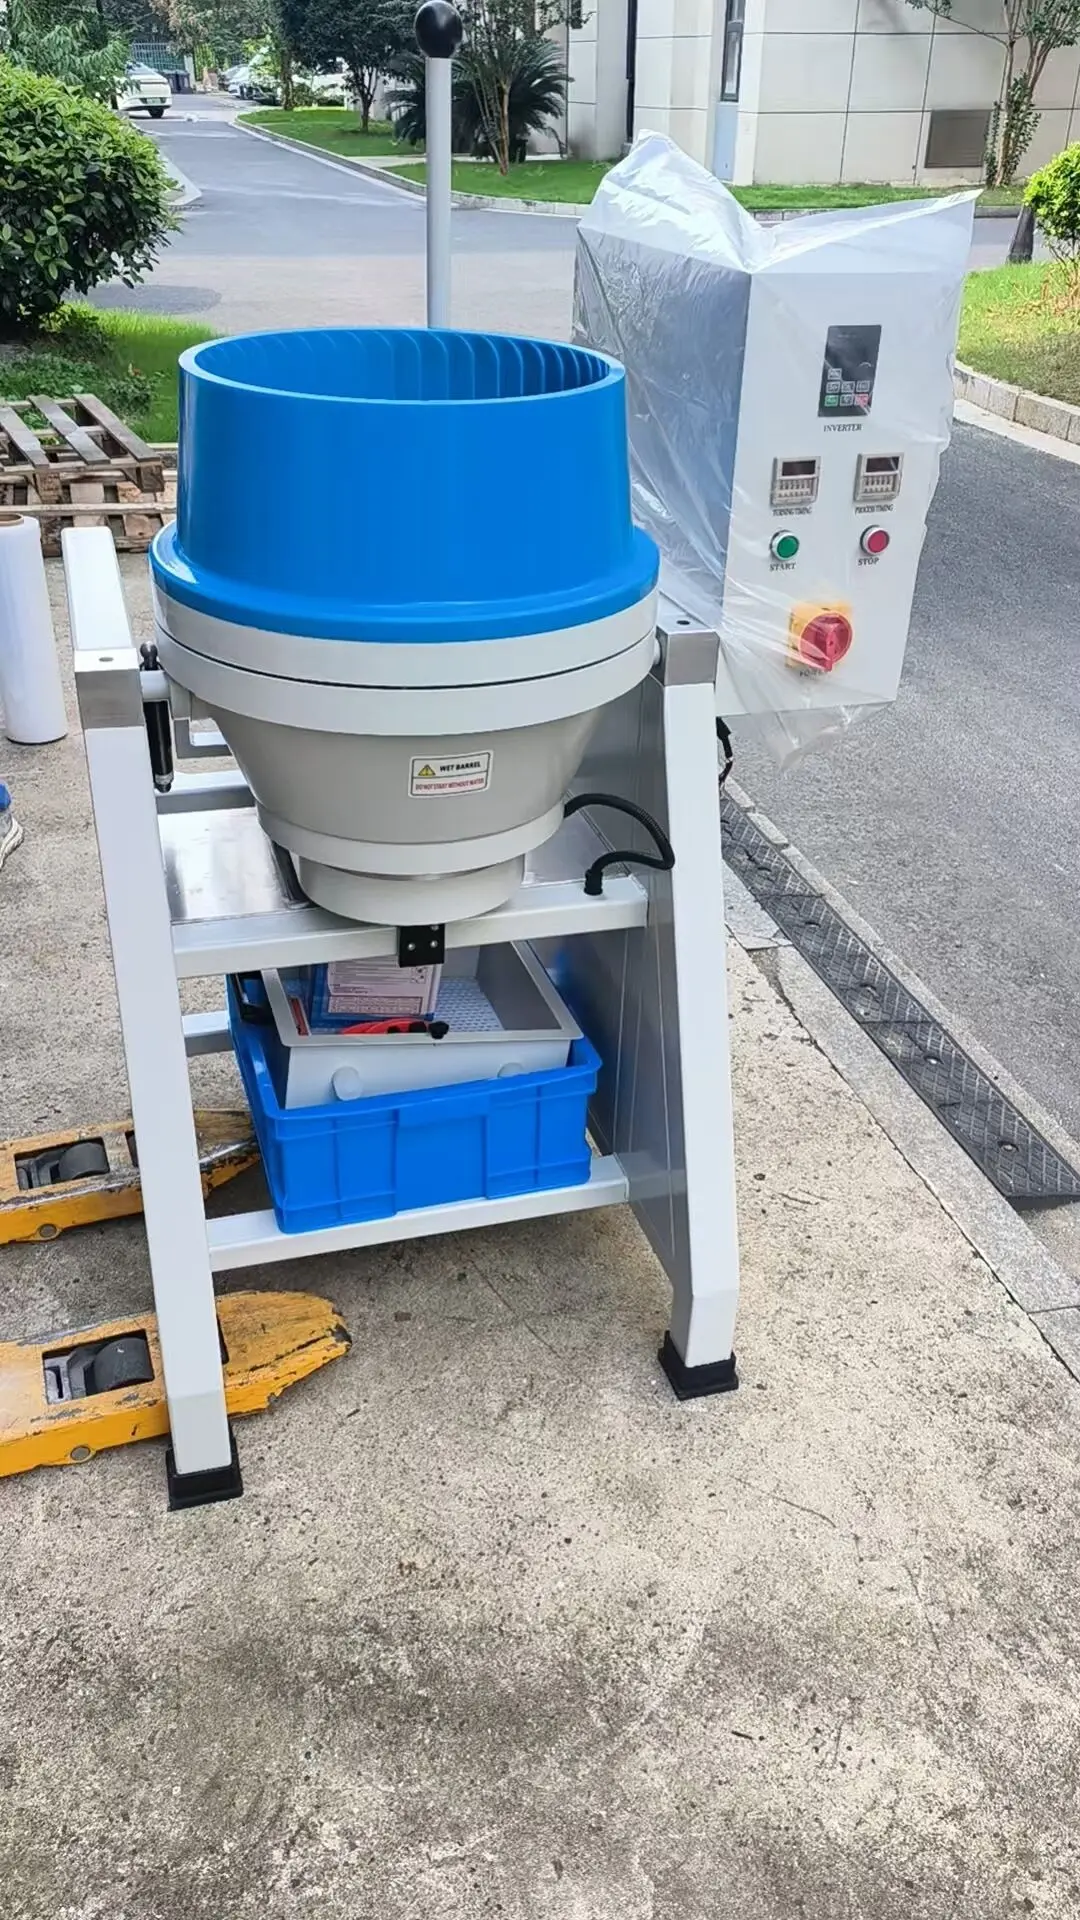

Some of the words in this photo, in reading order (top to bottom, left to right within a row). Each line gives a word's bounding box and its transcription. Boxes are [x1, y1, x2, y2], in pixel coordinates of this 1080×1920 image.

[823, 423, 862, 432] INVERTER
[857, 557, 880, 566] STOP
[769, 562, 796, 571] START
[440, 764, 454, 772] WET
[456, 761, 481, 771] BARREL
